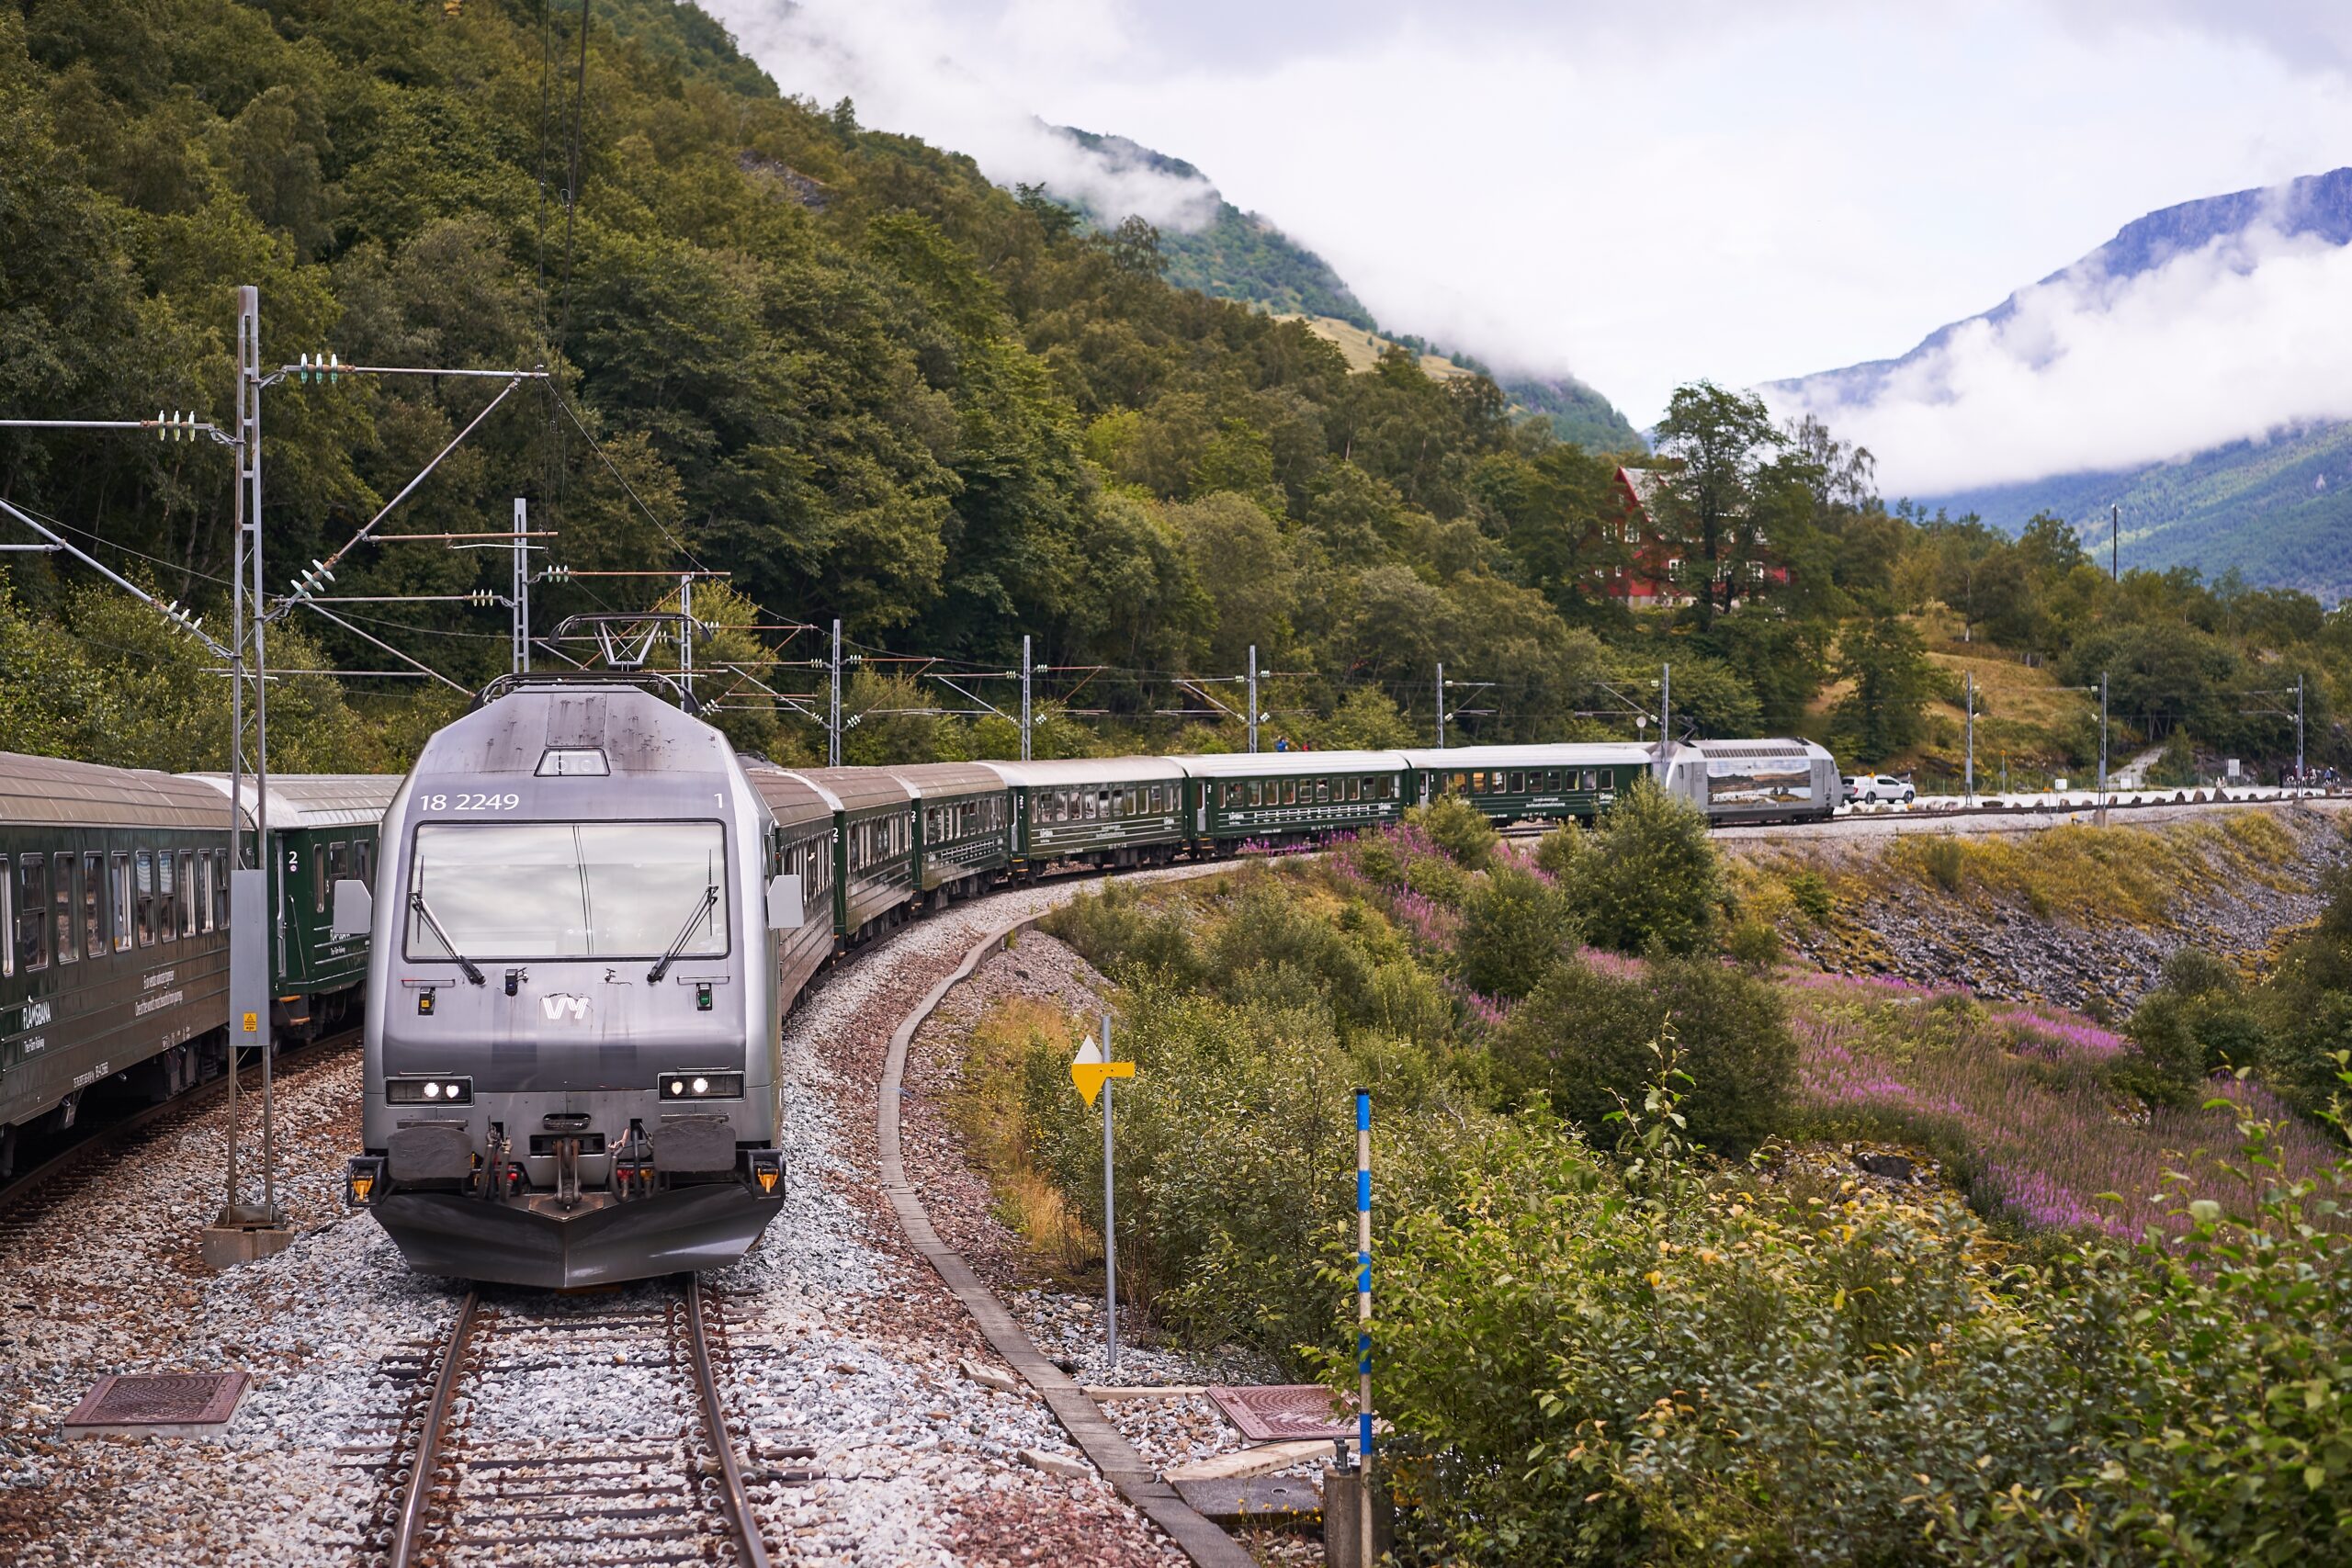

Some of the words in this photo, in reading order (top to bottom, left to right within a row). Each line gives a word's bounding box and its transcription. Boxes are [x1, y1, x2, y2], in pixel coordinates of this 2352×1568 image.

[420, 794, 447, 811] 18
[454, 793, 520, 810] 2249
[714, 793, 723, 809] 1
[911, 810, 917, 819] 2
[832, 828, 839, 837] 2
[288, 852, 299, 864] 2
